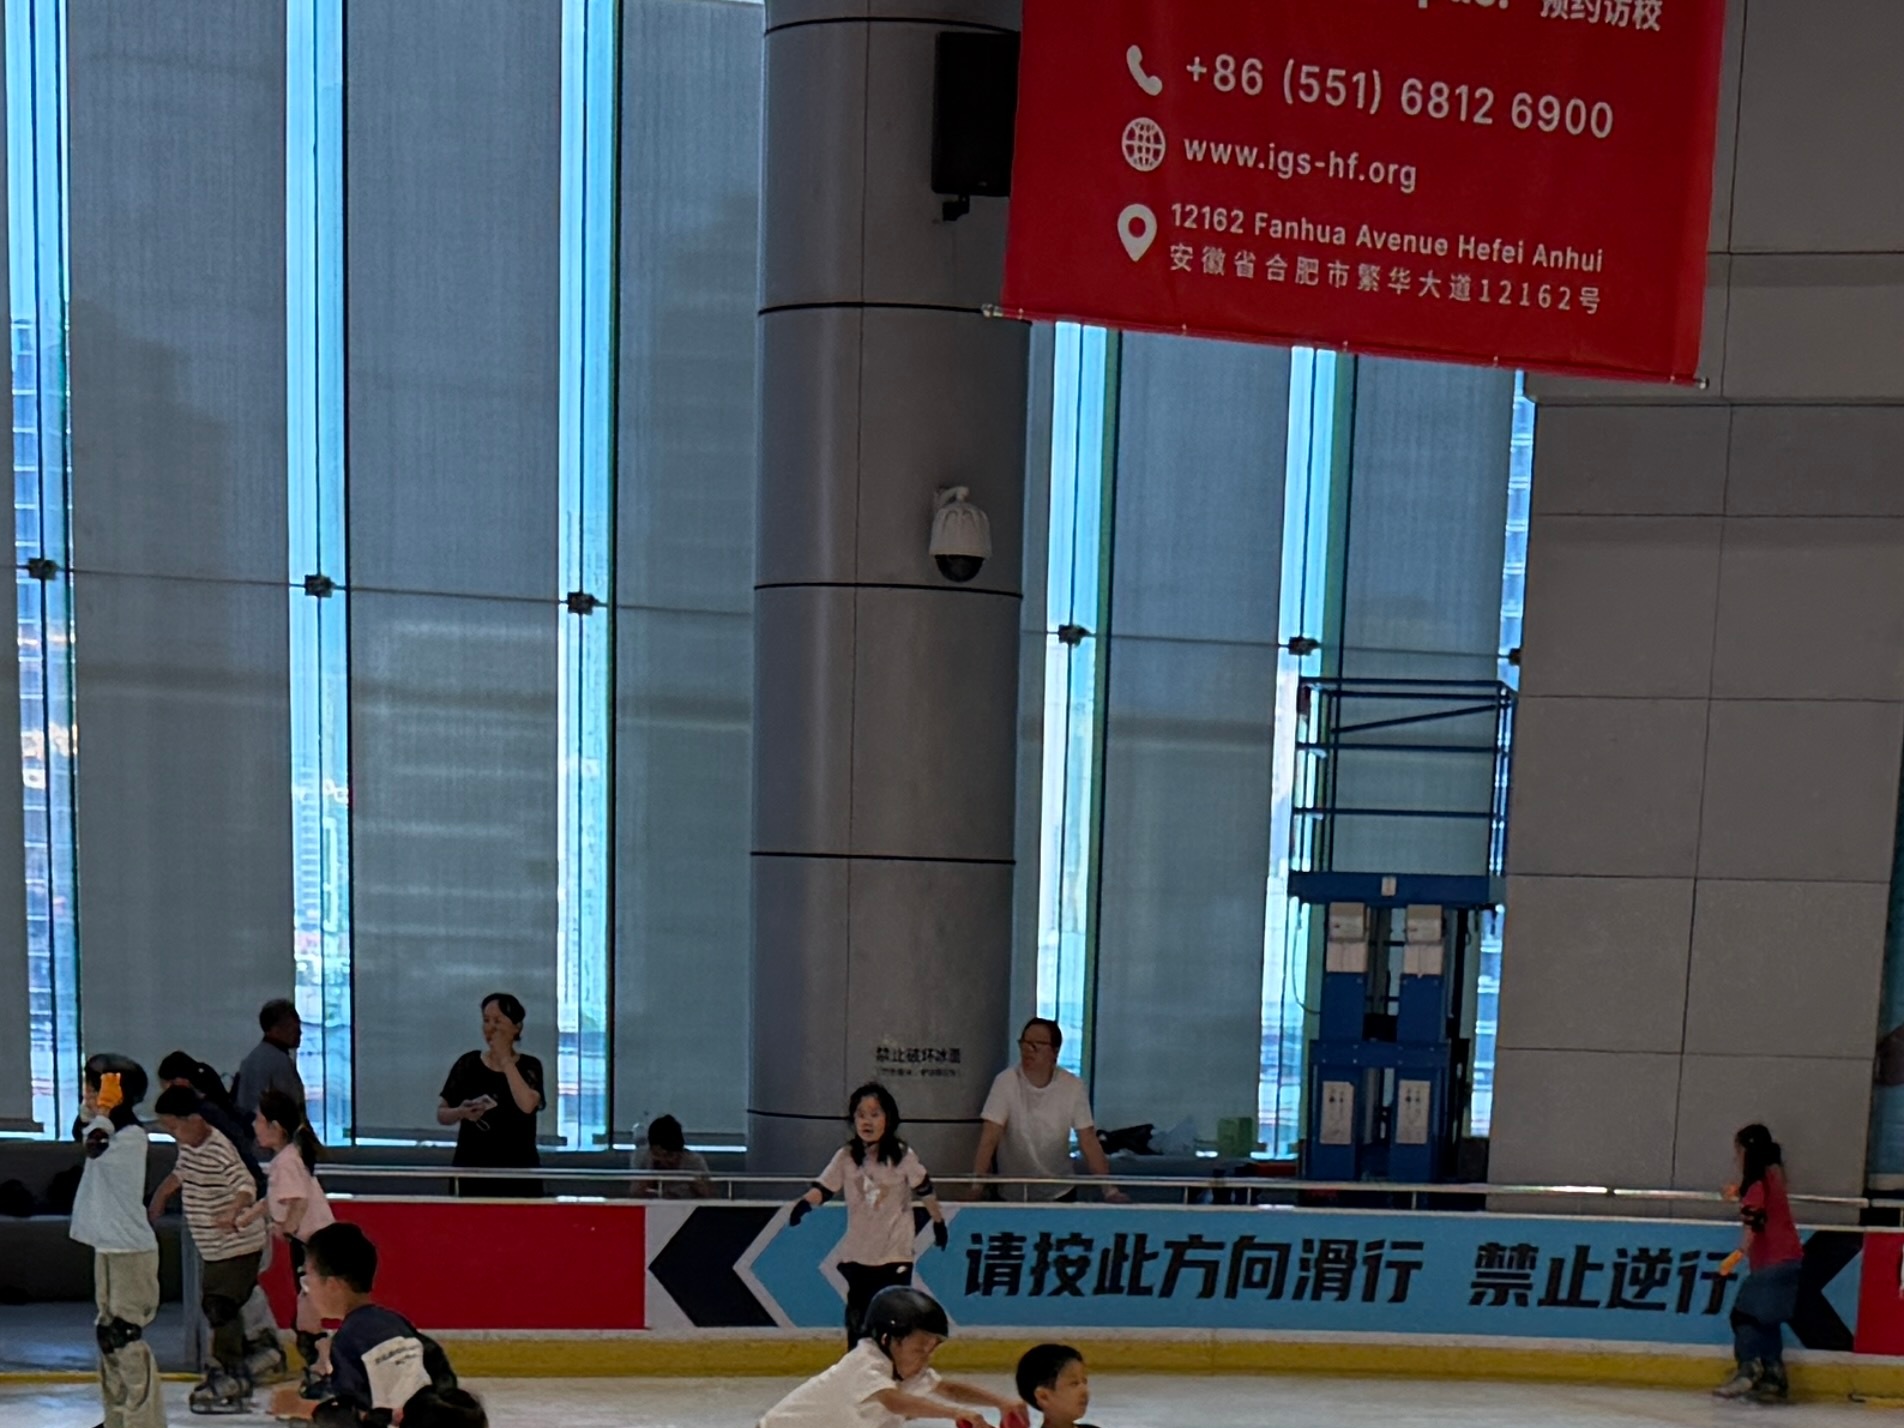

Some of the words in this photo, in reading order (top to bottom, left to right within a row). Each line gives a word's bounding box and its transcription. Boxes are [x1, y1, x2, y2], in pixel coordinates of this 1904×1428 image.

[1186, 53, 1264, 97] +86
[1283, 57, 1382, 115] (551)
[1400, 77, 1494, 125] 6812
[1510, 92, 1614, 139] 6900
[1183, 138, 1418, 194] www.igs-hf.org
[1170, 202, 1245, 235] 12162
[1253, 213, 1347, 247] Fanhua
[1355, 224, 1449, 257] Avenue
[1457, 235, 1524, 265] Hefei
[1531, 243, 1604, 273] Anhui
[1169, 242, 1601, 314] 安徽省合肥市繁华大道12162号
[963, 1231, 1425, 1305] 请按此方向滑行
[1468, 1241, 1744, 1315] 禁止逆行
